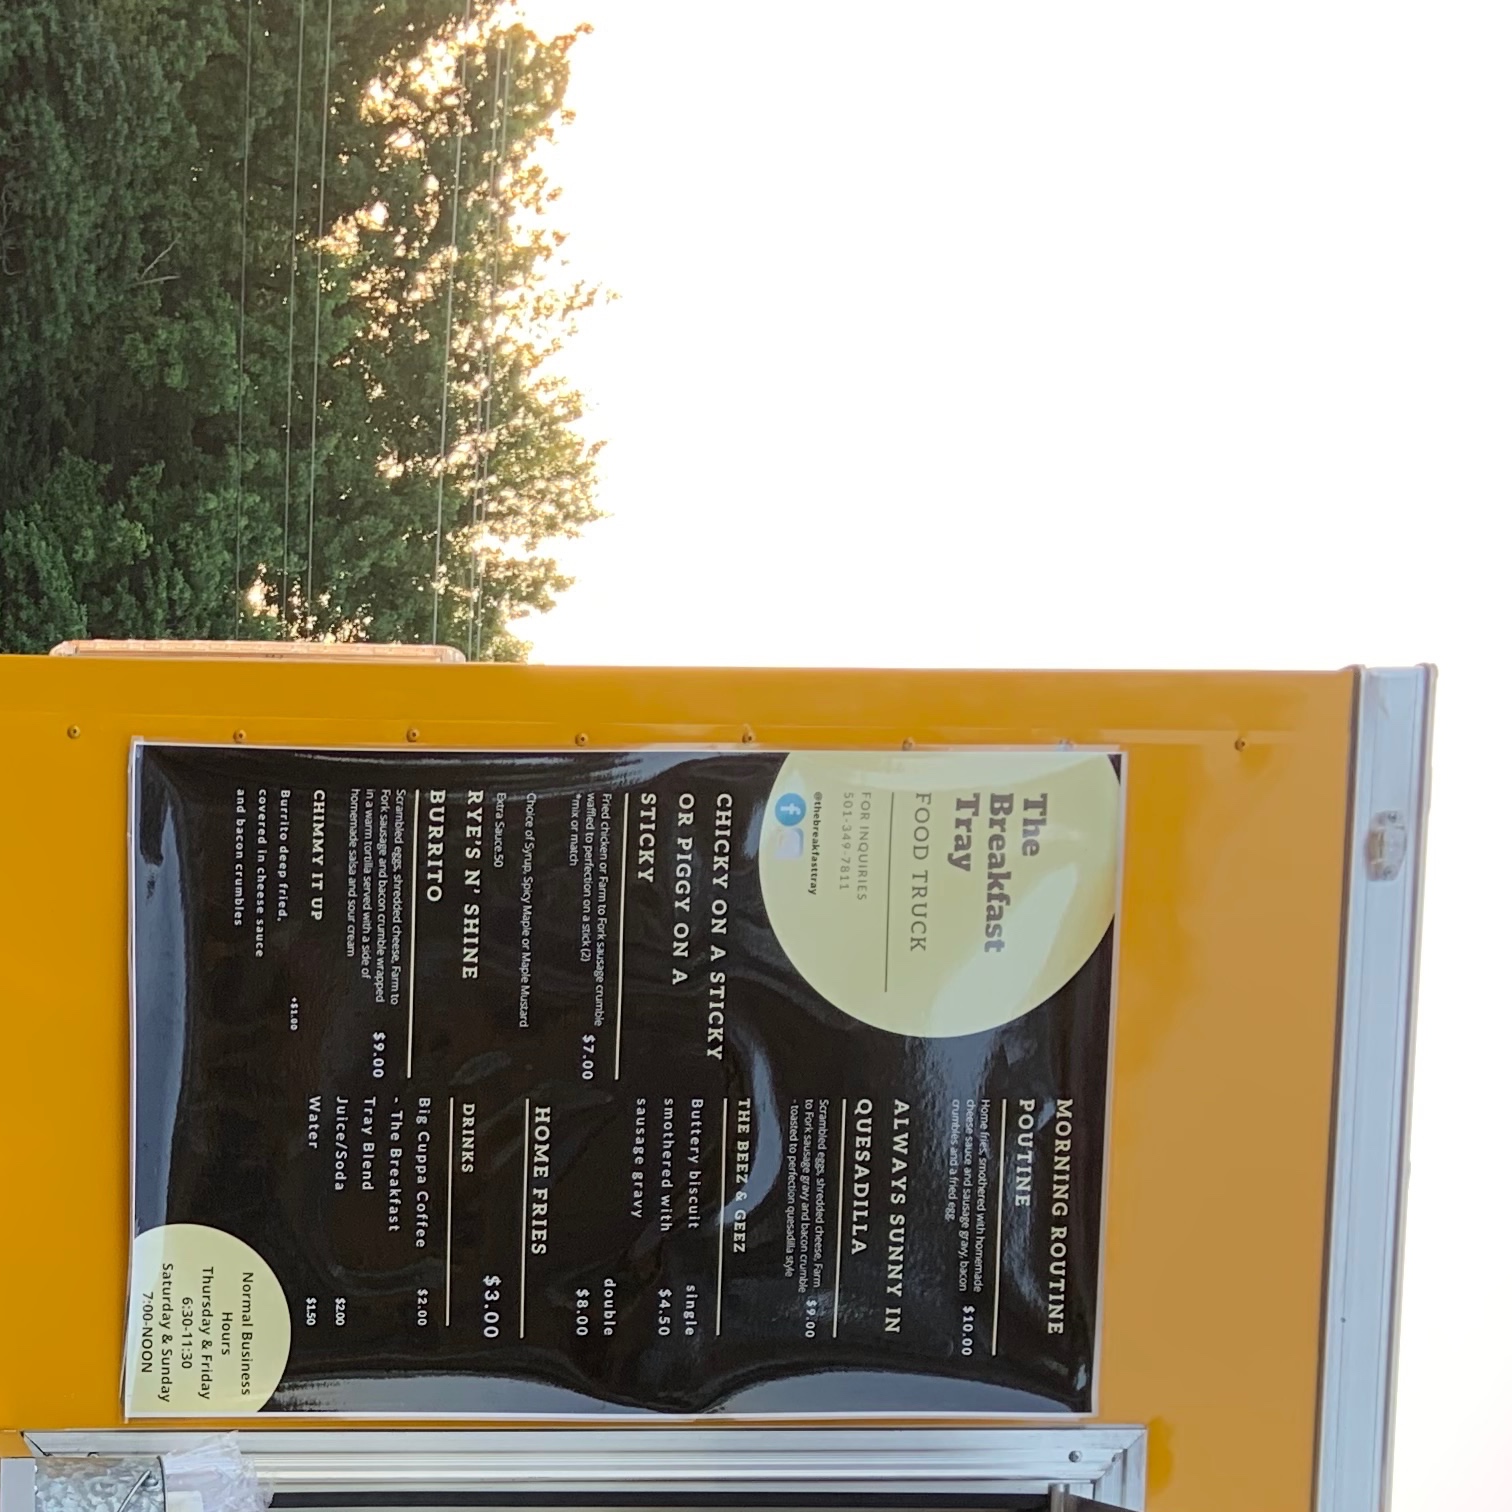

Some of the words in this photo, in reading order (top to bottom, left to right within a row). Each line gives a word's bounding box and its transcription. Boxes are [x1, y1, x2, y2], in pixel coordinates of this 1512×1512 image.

[236, 789, 246, 813] and
[256, 789, 267, 844] covered
[278, 790, 290, 840] Burrito
[466, 790, 484, 859] RYE'S
[495, 792, 506, 818] Extra
[585, 793, 596, 830] waffled
[600, 793, 611, 819] Fried
[678, 793, 694, 826] OR
[860, 792, 871, 820] FOR
[1022, 793, 1048, 856] The
[235, 818, 245, 859] bacon
[312, 790, 326, 866] CHIMMY
[426, 790, 446, 902] BURRITO
[570, 820, 580, 831] or
[585, 832, 594, 843] to
[599, 821, 610, 860] chicken
[638, 793, 656, 882] STICKY
[712, 793, 732, 888] CHICKY
[809, 792, 822, 895] @thebreakfasttray
[839, 792, 854, 890] 501-349-7811
[913, 792, 931, 860] FOOD
[948, 793, 980, 872] Tray
[256, 850, 266, 862] in
[276, 846, 290, 878] deep
[569, 834, 580, 866] match
[582, 845, 595, 897] perfection
[599, 862, 608, 874] or
[857, 826, 869, 900] INQUIRIES
[985, 793, 1014, 952] Breakfast
[234, 864, 244, 926] crumbles
[256, 867, 266, 914] cheese
[312, 873, 323, 890] IT
[464, 870, 481, 894] N'
[598, 876, 609, 902] Farm
[674, 837, 692, 912] PIGGY
[310, 897, 322, 920] UP
[584, 899, 592, 913] on
[596, 918, 607, 940] Fork
[597, 904, 607, 915] to
[711, 900, 727, 934] ON
[910, 870, 928, 952] TRUCK
[255, 919, 264, 957] sauce
[462, 904, 480, 979] SHINE
[580, 948, 592, 962] (2)
[581, 924, 593, 947] stick
[673, 923, 689, 958] ON
[710, 945, 725, 961] A
[594, 942, 605, 982] sausage
[672, 968, 688, 984] A
[594, 984, 605, 1026] crumble
[706, 972, 725, 1060] STICKY
[372, 1032, 386, 1078] $9.00
[581, 1034, 596, 1080] $7.00
[308, 1096, 321, 1149] Water
[361, 1097, 375, 1135] Tray
[390, 1111, 402, 1142] The
[416, 1097, 431, 1125] Big
[633, 1098, 647, 1165] sausage
[688, 1099, 703, 1164] Buttery
[737, 1098, 750, 1134] THE
[333, 1097, 348, 1191] Juice/Soda
[416, 1131, 430, 1184] Cuppa
[462, 1103, 475, 1173] DRINKS
[533, 1106, 551, 1178] HOME
[661, 1098, 676, 1188] smothered
[891, 1099, 910, 1205] ALWAYS
[1014, 1099, 1035, 1207] POUTINE
[1051, 1099, 1073, 1217] MORNING
[362, 1142, 374, 1190] Blend
[736, 1141, 749, 1184] BEEZ
[851, 1099, 873, 1255] QUESADILLA
[388, 1149, 401, 1232] Breakfast
[630, 1172, 644, 1218] gravy
[660, 1194, 672, 1232] with
[688, 1170, 701, 1229] biscuit
[736, 1191, 747, 1202] &
[415, 1191, 428, 1248] Coffee
[531, 1188, 548, 1254] FRIES
[733, 1210, 746, 1253] GEEZ
[887, 1214, 905, 1297] SUNNY
[159, 1263, 173, 1330] Saturday
[198, 1267, 213, 1335] Thursday
[241, 1272, 254, 1327] Normal
[1048, 1226, 1067, 1335] ROUTINE
[305, 1298, 317, 1325] $1.50
[334, 1298, 346, 1325] $2.00
[416, 1289, 428, 1326] $2.00
[483, 1275, 501, 1338] $3.00
[575, 1288, 589, 1336] $8.00
[604, 1278, 616, 1336] double
[658, 1288, 672, 1336] $4.50
[683, 1285, 698, 1336] single
[805, 1300, 817, 1338] $9.00
[884, 1307, 901, 1333] IN
[961, 1305, 975, 1356] $10.00
[141, 1292, 153, 1373] 7:00-NOON
[161, 1334, 172, 1345] &
[181, 1297, 193, 1369] 6:30-11:30
[201, 1340, 212, 1350] &
[221, 1311, 233, 1355] Hours
[158, 1349, 172, 1402] Sunday
[198, 1354, 212, 1400] Friday
[241, 1332, 253, 1395] Business
